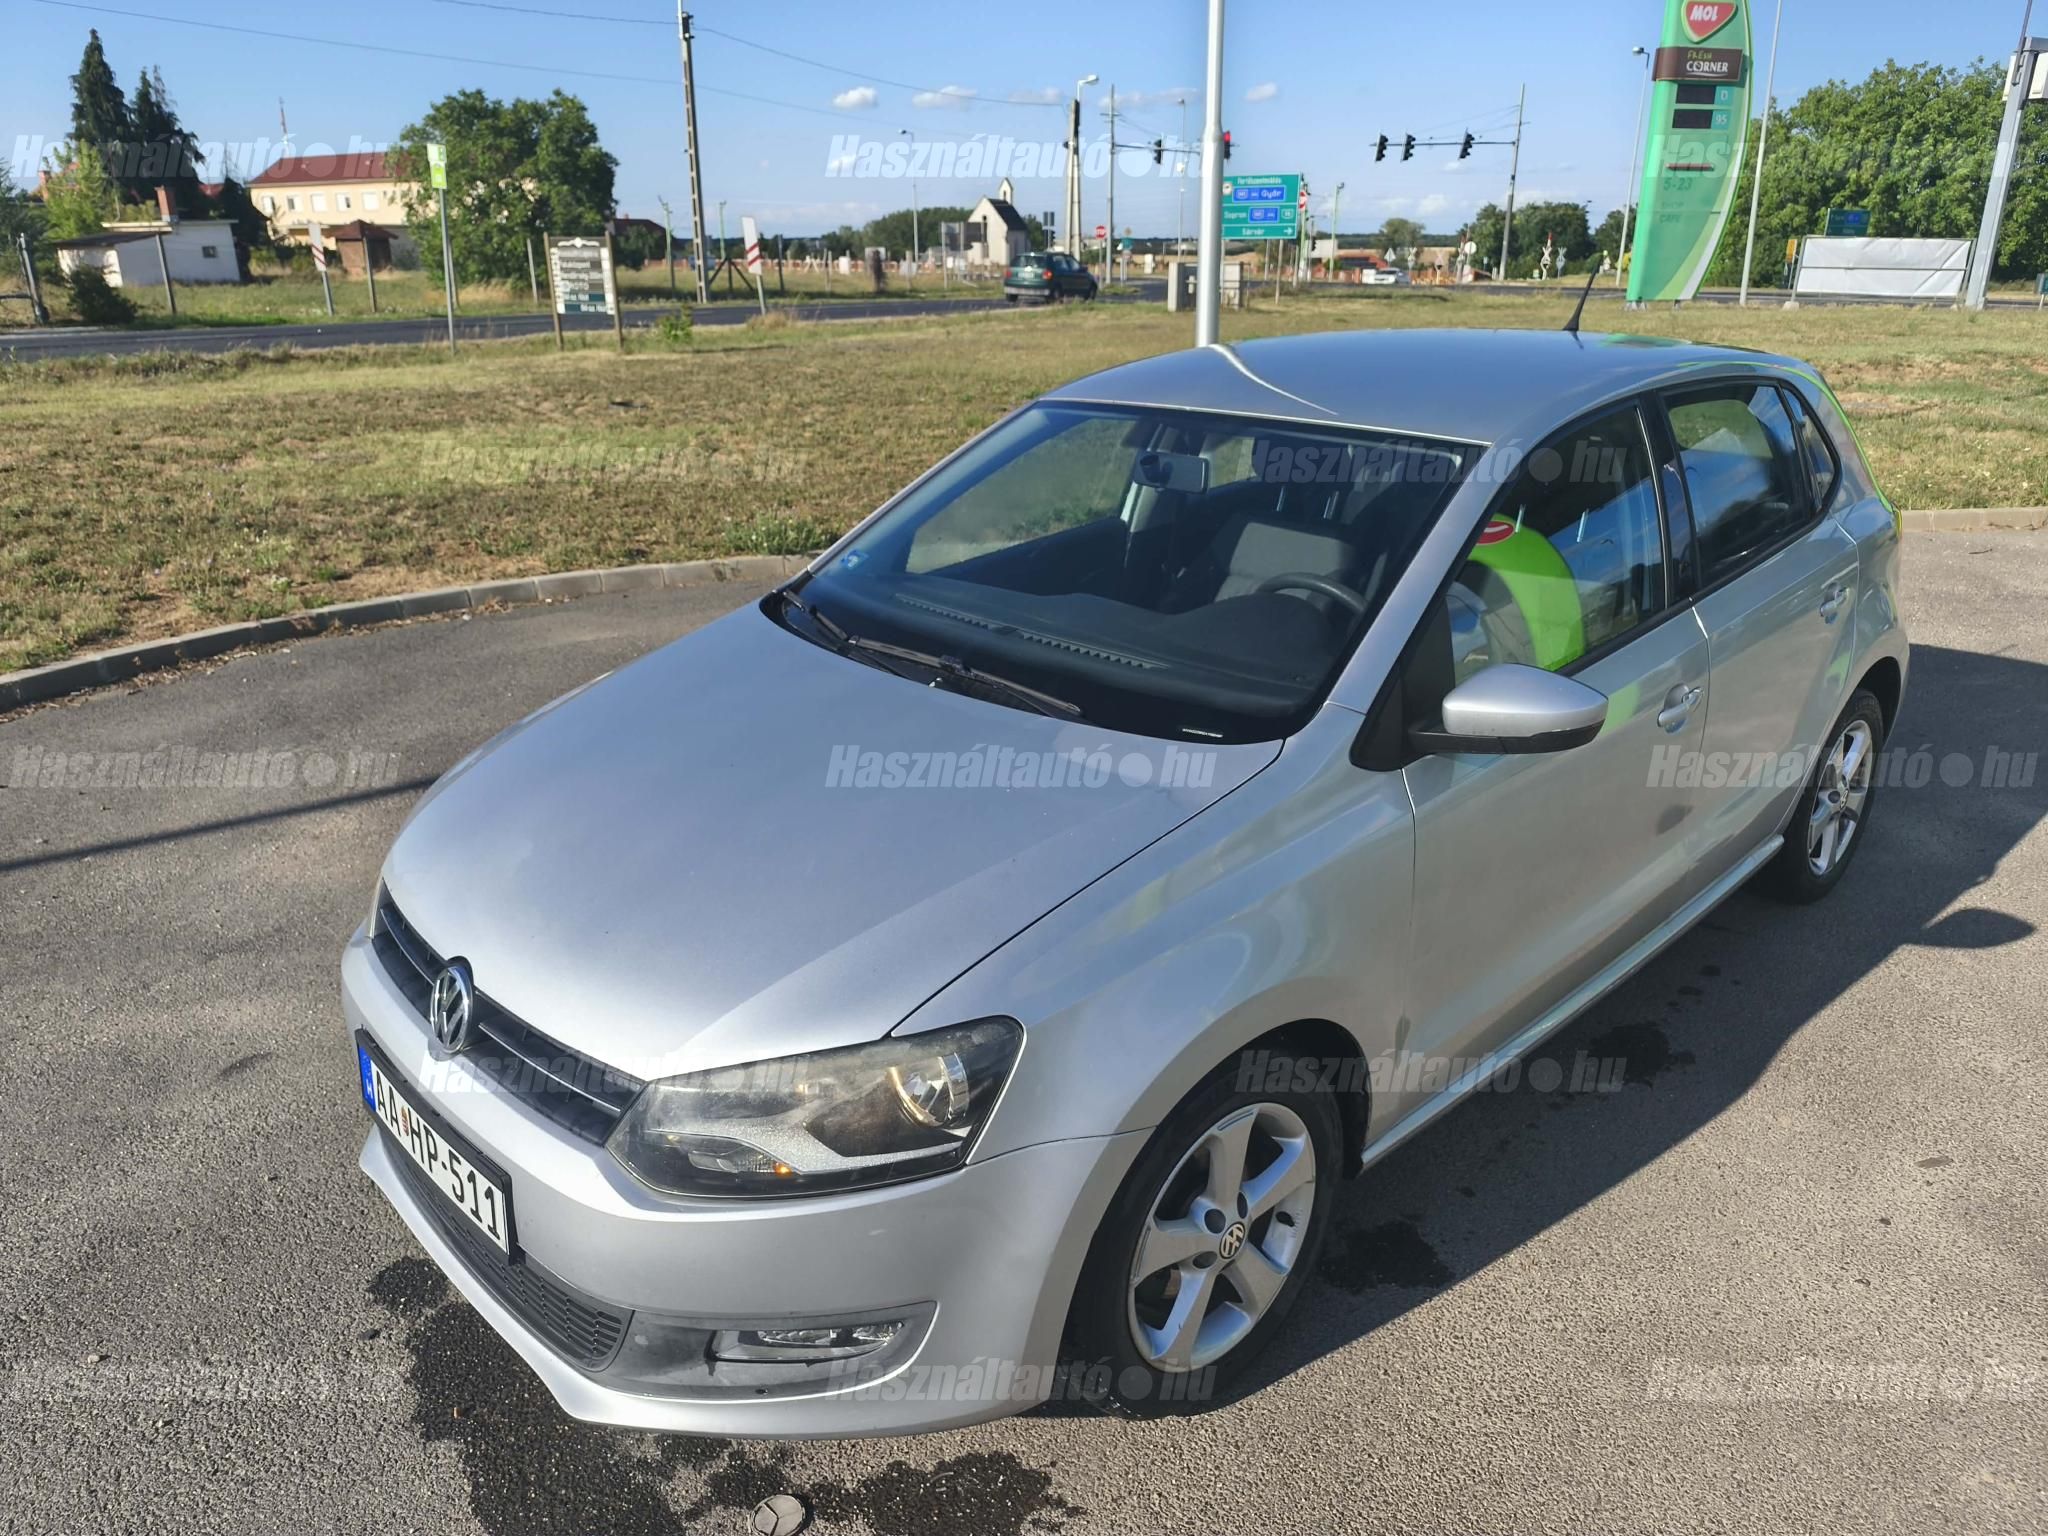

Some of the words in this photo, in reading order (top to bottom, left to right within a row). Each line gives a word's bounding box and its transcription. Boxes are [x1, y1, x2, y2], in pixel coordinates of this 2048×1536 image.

[1690, 5, 1719, 21] MOL
[1687, 50, 1712, 60] FRESH
[1686, 61, 1729, 73] CORNER
[1715, 114, 1727, 125] 95
[376, 1070, 401, 1137] AA
